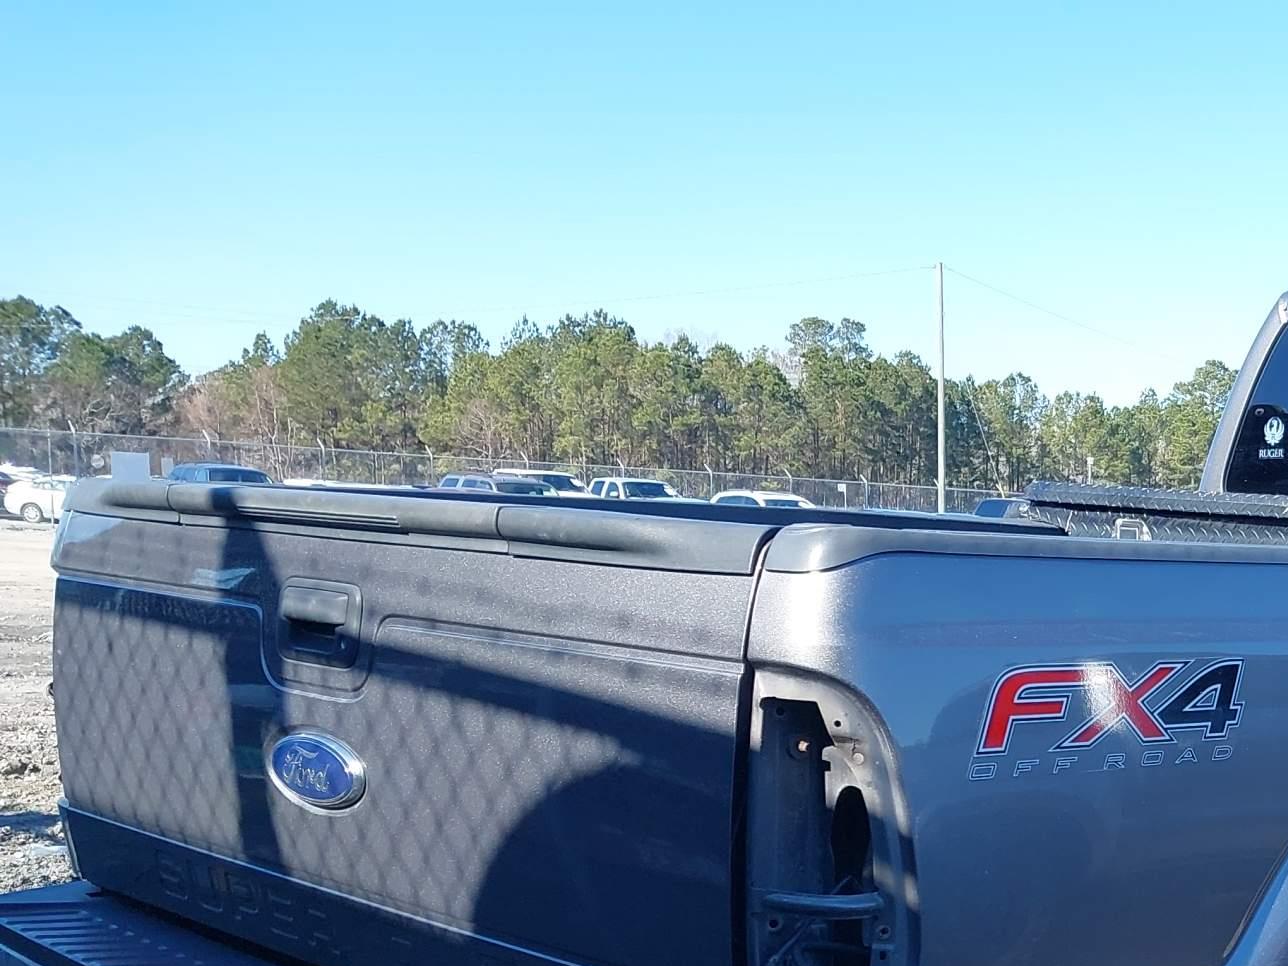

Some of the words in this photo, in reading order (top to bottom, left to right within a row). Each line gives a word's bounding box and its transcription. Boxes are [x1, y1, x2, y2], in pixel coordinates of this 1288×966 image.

[1258, 448, 1285, 460] RUGER
[974, 657, 1245, 757] FX4
[282, 742, 331, 793] Ford
[967, 756, 1079, 781] OFF
[1103, 745, 1233, 770] ROAD
[153, 847, 343, 957] SUPER
